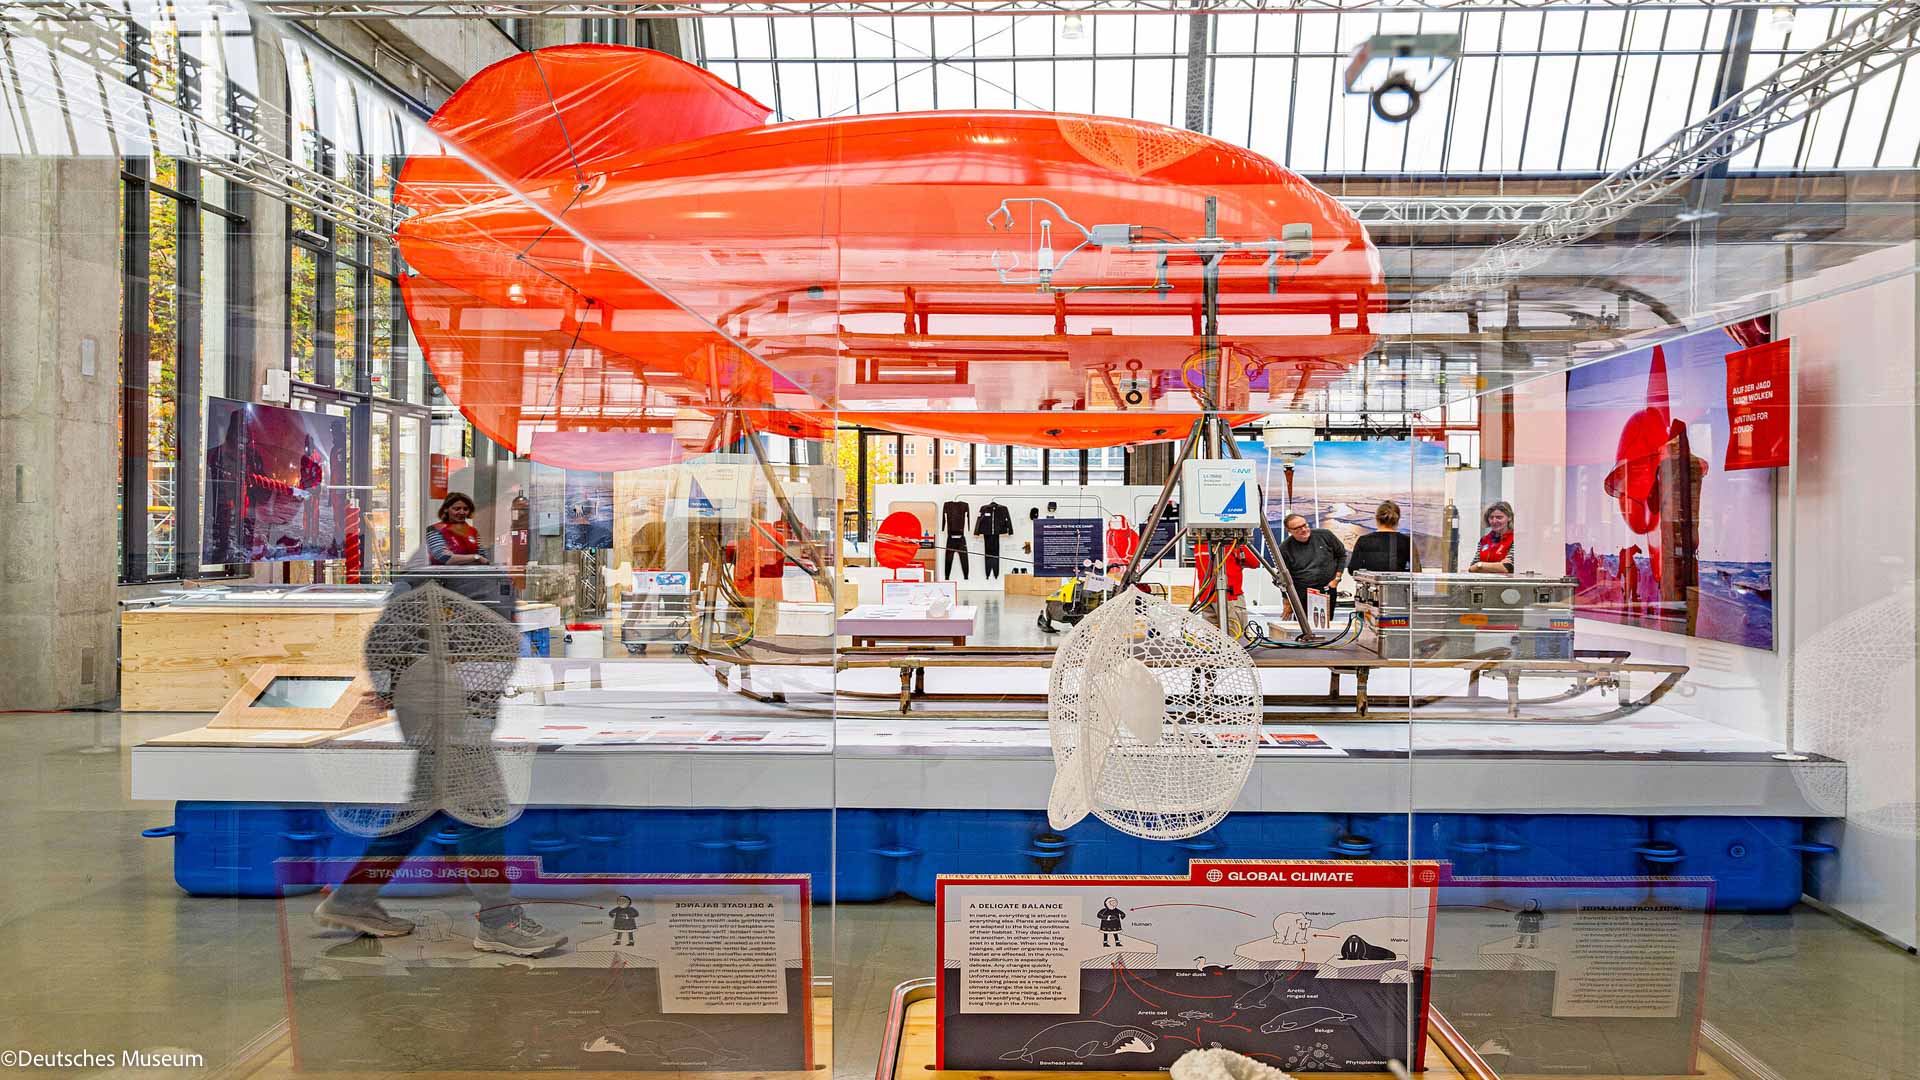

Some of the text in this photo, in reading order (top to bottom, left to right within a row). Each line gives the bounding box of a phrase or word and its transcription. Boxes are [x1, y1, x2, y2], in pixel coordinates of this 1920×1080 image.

[1757, 412, 1768, 420] FOR
[1228, 872, 1354, 882] GLOBAL CLIMATE
